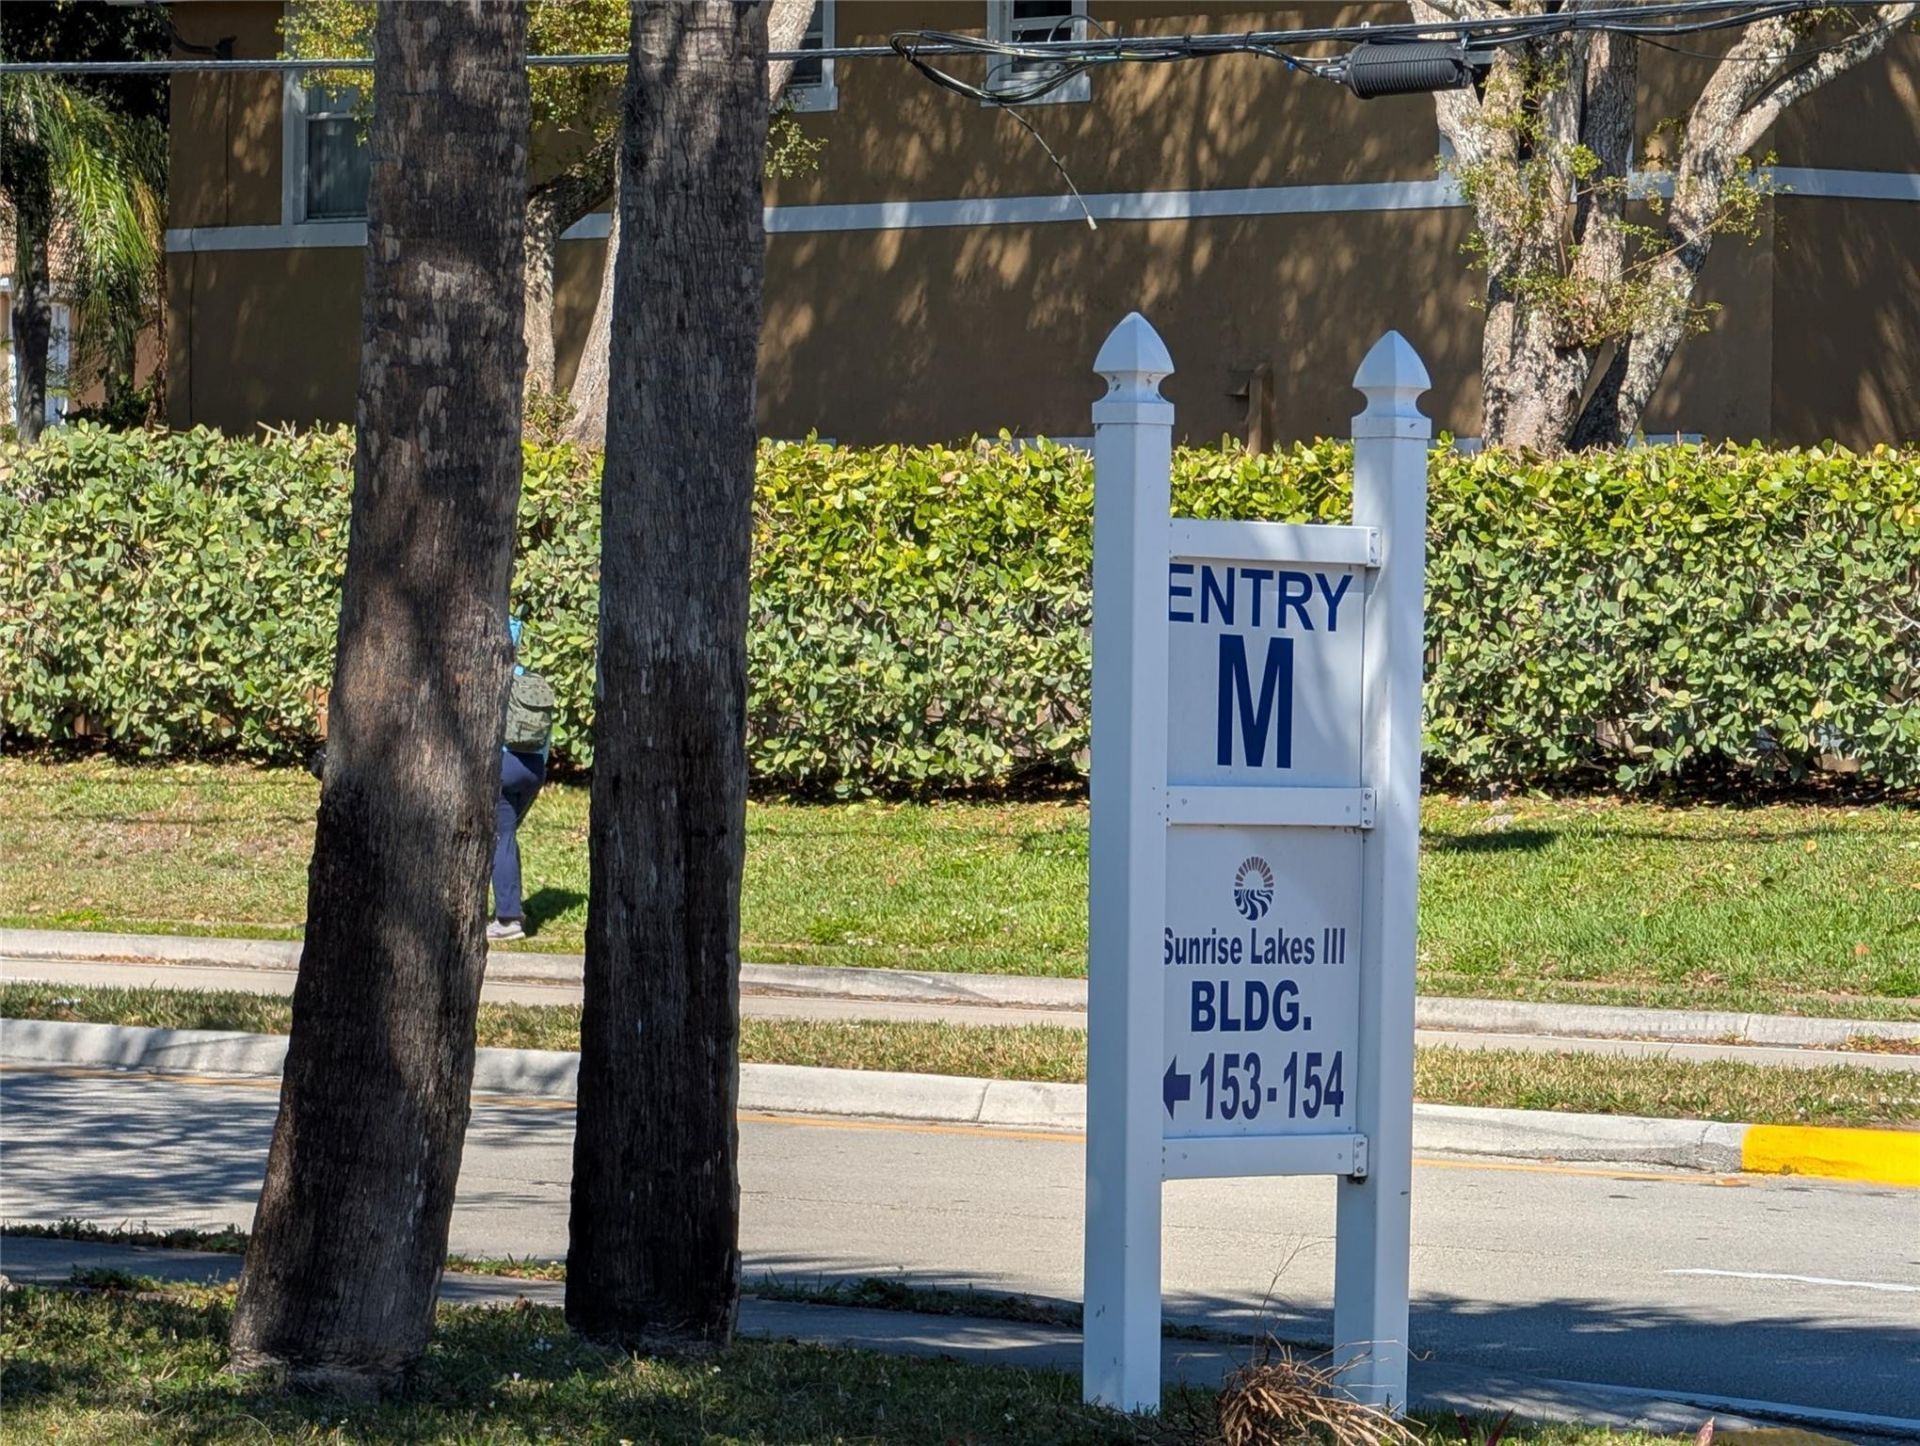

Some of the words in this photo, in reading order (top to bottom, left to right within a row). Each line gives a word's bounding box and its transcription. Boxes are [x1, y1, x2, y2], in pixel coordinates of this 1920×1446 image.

[1168, 563, 1354, 632] ENTRY
[1217, 633, 1294, 769] M
[1164, 927, 1243, 966] Sunrise
[1250, 927, 1316, 966] Lakes
[1322, 927, 1346, 965] III
[1190, 979, 1312, 1033] BLDG.
[1200, 1050, 1345, 1121] 153-154
